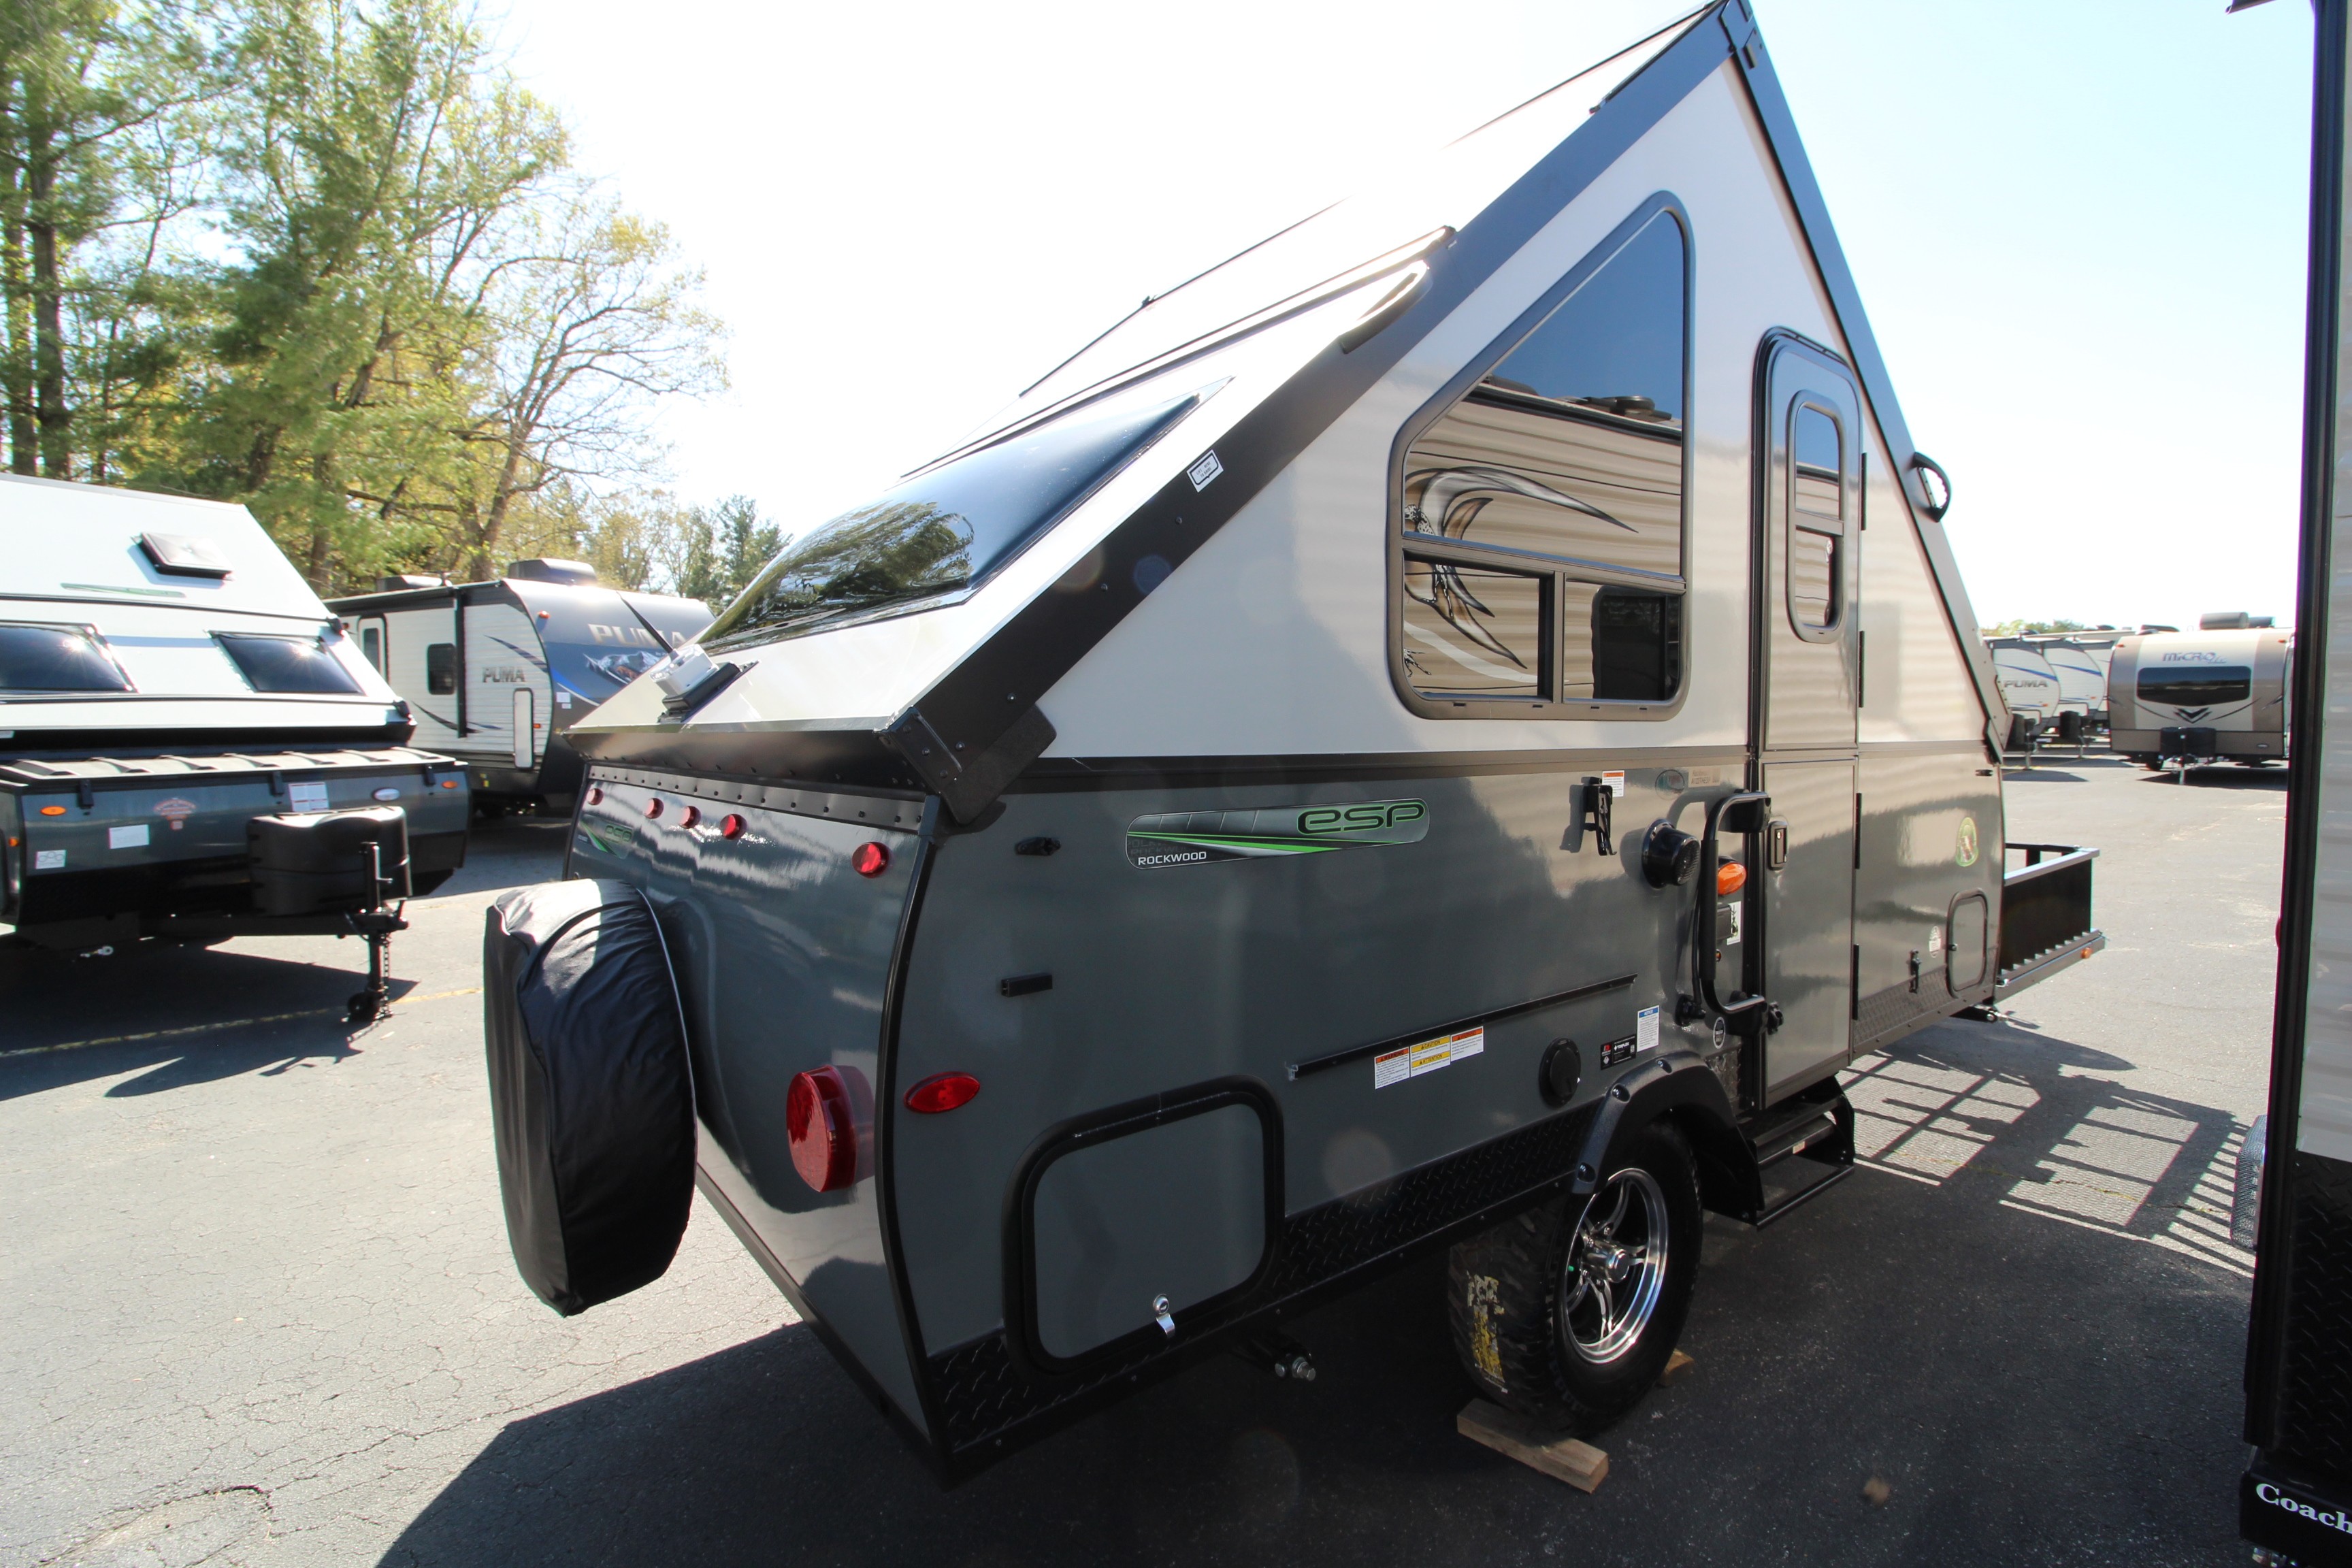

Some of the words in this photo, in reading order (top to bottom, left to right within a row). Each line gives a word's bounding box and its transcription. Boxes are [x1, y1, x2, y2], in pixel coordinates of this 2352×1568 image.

[588, 623, 687, 647] PUMA
[483, 666, 526, 683] PUMA
[1138, 851, 1207, 866] ROCKWOOD
[1424, 1040, 1441, 1049] CAUTION
[1384, 1050, 1404, 1060] WARNING
[1423, 1054, 1443, 1063] ATTENTION
[2256, 1484, 2352, 1534] Coach
